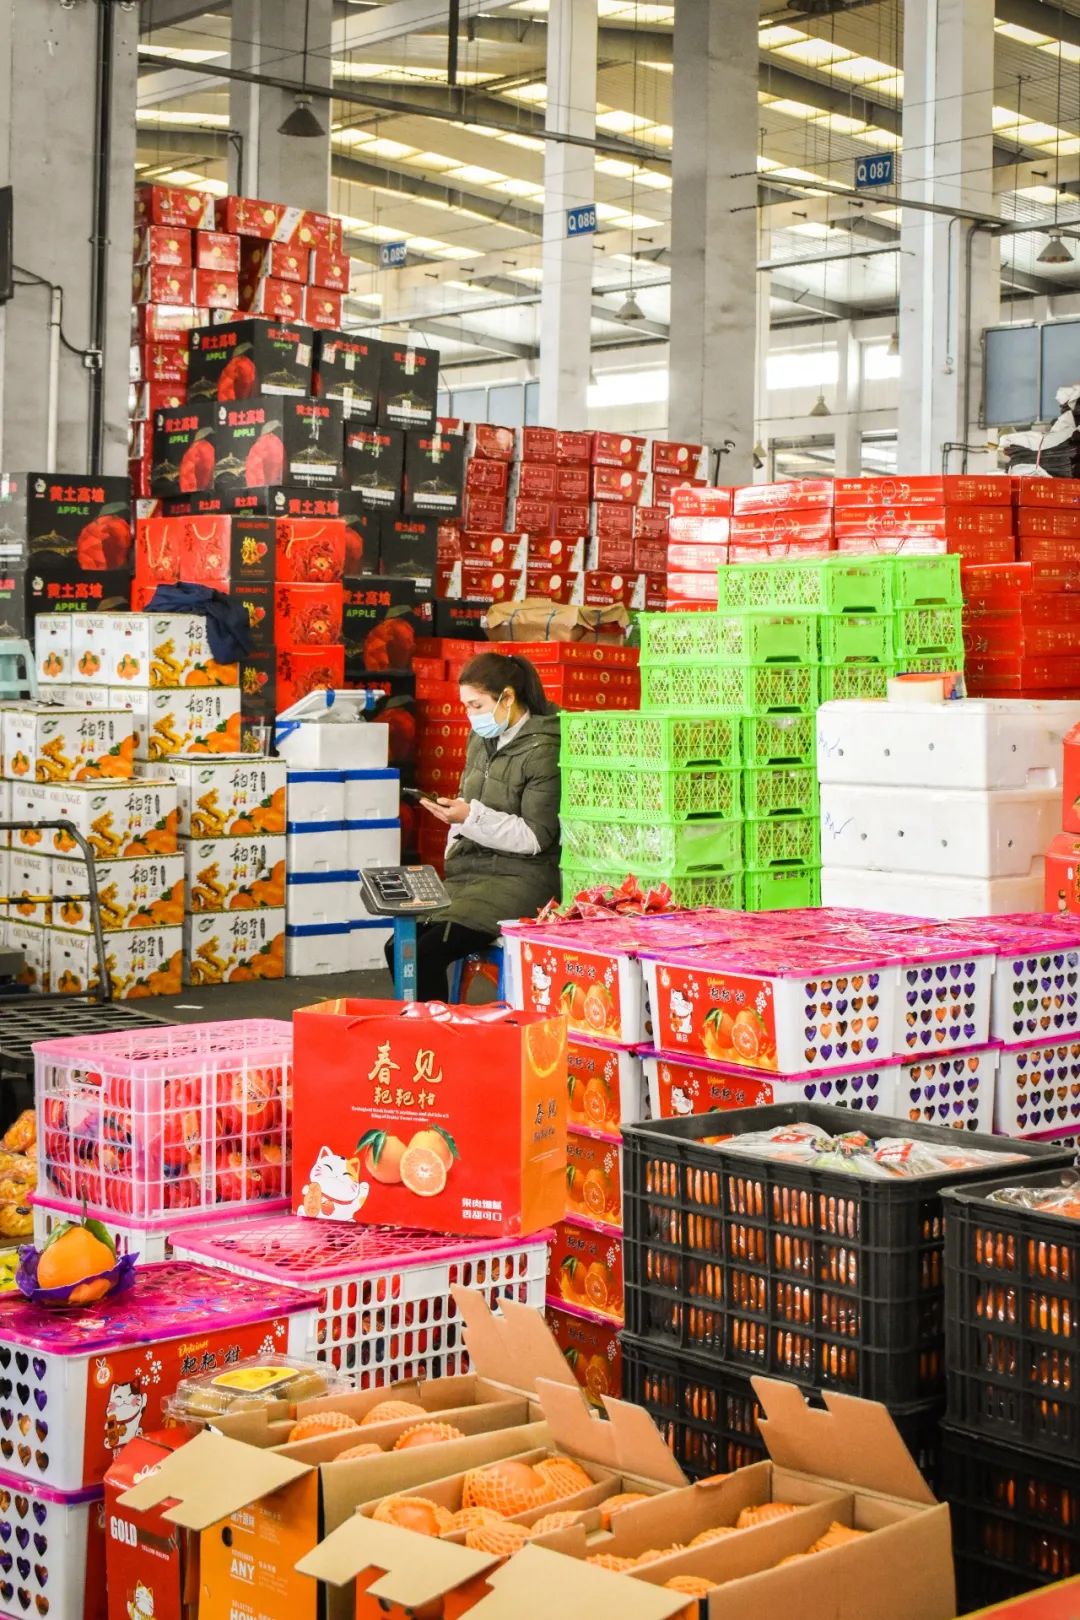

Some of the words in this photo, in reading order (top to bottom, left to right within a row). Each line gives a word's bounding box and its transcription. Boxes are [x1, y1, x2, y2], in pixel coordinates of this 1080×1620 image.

[857, 165, 867, 182] Q
[870, 162, 890, 180] 087
[568, 215, 577, 231] Q
[578, 211, 596, 228] 086
[206, 350, 227, 361] APPLE
[233, 427, 255, 438] APPLE
[168, 434, 189, 444] APPLE
[57, 505, 90, 516] APPLE
[54, 602, 88, 612] APPLE
[346, 609, 377, 618] APPLE
[368, 1040, 443, 1086] 春见
[110, 1515, 138, 1548] GOLD
[231, 1558, 255, 1581] ANY
